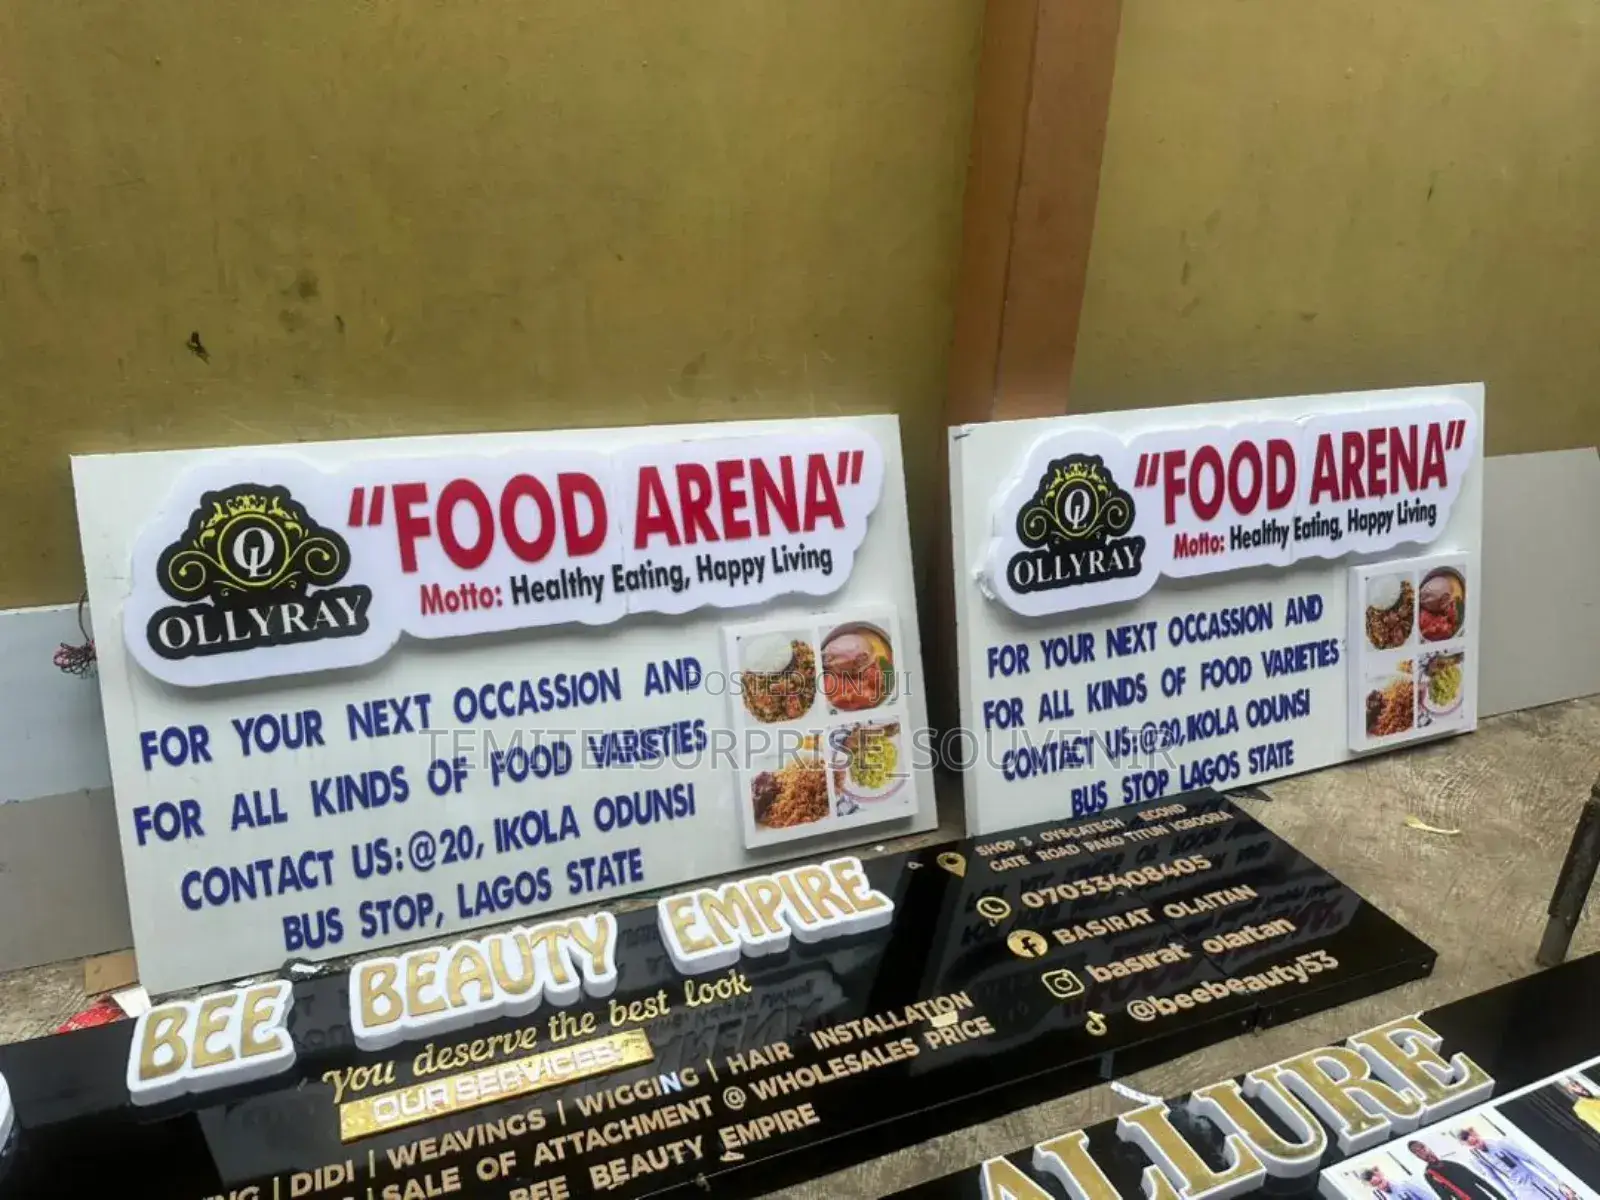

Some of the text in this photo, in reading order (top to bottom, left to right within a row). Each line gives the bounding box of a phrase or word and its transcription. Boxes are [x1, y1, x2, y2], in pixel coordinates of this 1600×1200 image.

[1013, 545, 1141, 586] OLLYRAY
[1173, 499, 1437, 559] Motto: Healthy Eating, Happy Living
[157, 594, 364, 649] OLLYRAY
[420, 544, 833, 616] Motto: Healthy Eating, Happy Living
[988, 594, 1324, 679] FOR YOUR NEXT OCCASSION AND
[139, 656, 703, 771] FOR YOUR NEXT OCCASSION AND
[983, 638, 1340, 730] FOR ALL KINDS OF FOOD VARIETIES
[1002, 737, 1095, 782] CONTACT
[1246, 689, 1310, 728] ODUNSI
[133, 718, 708, 846] FOR ALL KINDS OF FOOD VARIETIES
[1071, 739, 1295, 820] BUS STOP LAGOS STATE
[181, 850, 335, 911] CONTACT
[494, 804, 581, 854] IKOLA
[594, 782, 696, 832] ODUNSI
[975, 839, 1016, 857] SHOP
[989, 854, 1031, 872] GATE
[1035, 843, 1081, 862] ROAD
[1020, 853, 1213, 909] 07033408405
[282, 847, 644, 952] BUS STOP, LAGOS STATE
[1050, 883, 1260, 946] BASIRAT OLAITAN
[134, 858, 889, 1087] BEE BEAUTY EMPIRE
[1126, 949, 1340, 1022] @beebeauty53
[412, 1025, 538, 1077] deserve
[547, 1009, 597, 1043] the
[608, 988, 671, 1027] best
[683, 968, 753, 1008] look
[290, 990, 975, 1198] DIDI WEAVINGS WIGGING HAIR INSTALLATION
[372, 1078, 450, 1124] OUR
[381, 1166, 462, 1200] SALE
[476, 1150, 516, 1182] OF
[533, 1094, 713, 1167] ATTACHMENT
[922, 1015, 997, 1050] PRICE
[588, 1134, 704, 1191] BEAUTY
[718, 1102, 821, 1150] EMPIRE
